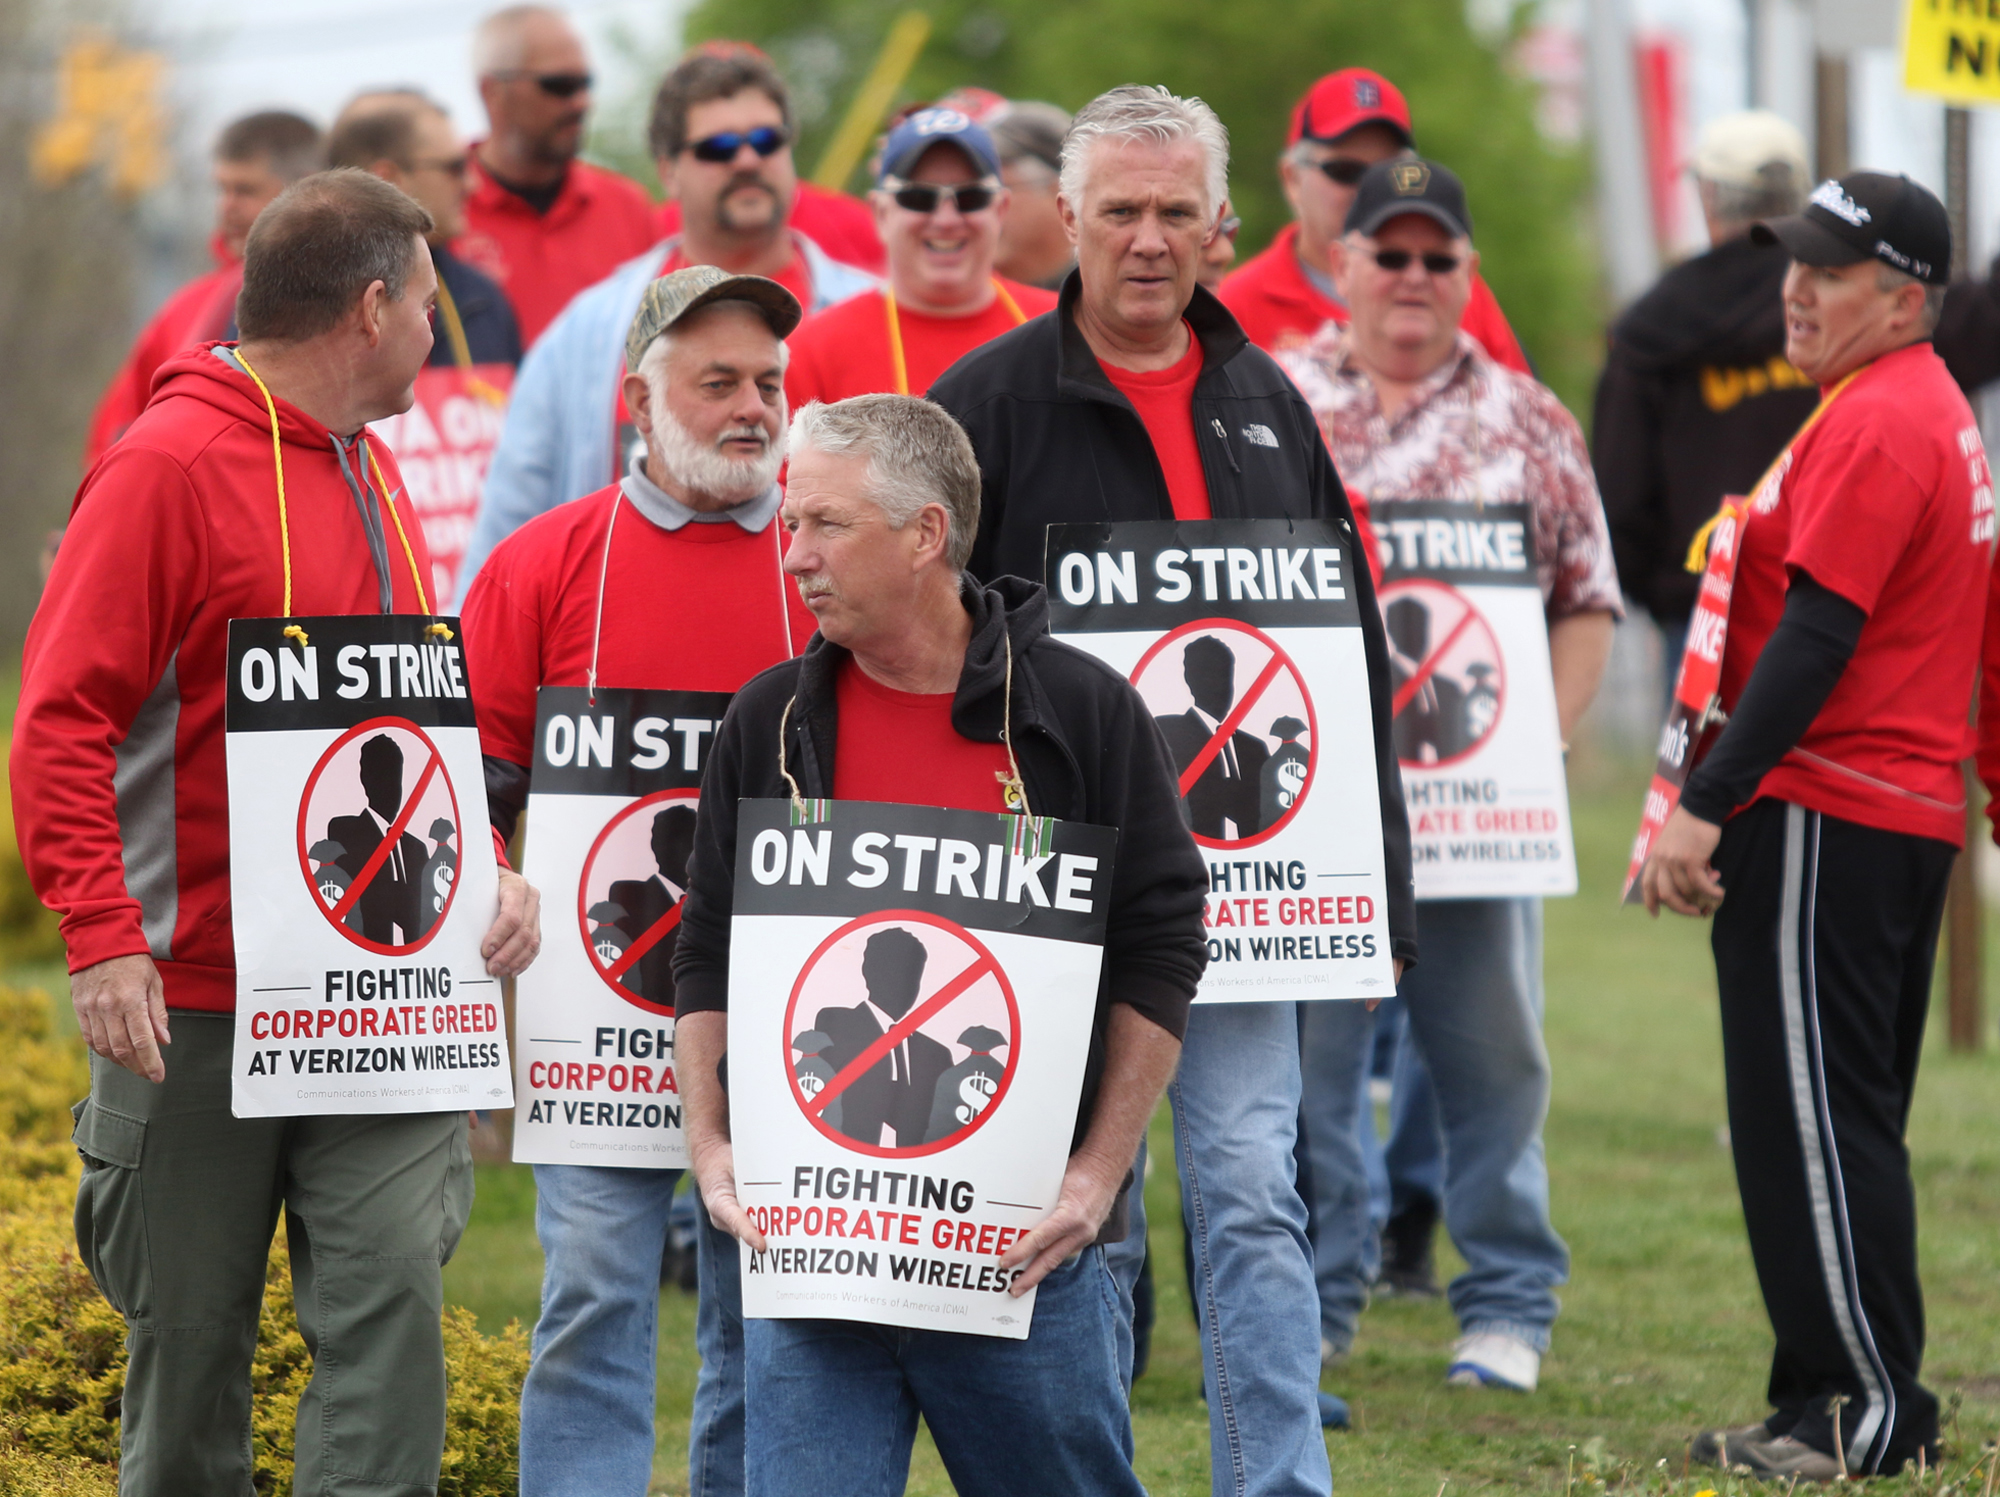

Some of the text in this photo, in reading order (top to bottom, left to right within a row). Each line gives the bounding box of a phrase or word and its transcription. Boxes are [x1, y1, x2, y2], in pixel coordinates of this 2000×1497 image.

[1060, 547, 1346, 606] ON STRIKE
[240, 644, 467, 702] ON STRIKE
[546, 714, 723, 771] ON ST
[1405, 778, 1499, 806] HTING
[1474, 808, 1558, 835] GREED
[1411, 838, 1562, 864] ON WIRELESS
[751, 828, 1099, 914] ON STRIKE
[1210, 860, 1307, 893] HTING
[1200, 896, 1375, 928] RATE GREED
[1206, 934, 1377, 963] ON WIRELESS
[325, 966, 452, 1003] FIGHTING
[1217, 976, 1254, 988] Workers
[1267, 974, 1302, 986] America
[251, 1003, 498, 1040] CORPORATE GREED
[247, 1042, 501, 1076] AT VERIZON WIRELESS
[595, 1026, 676, 1060] FIGH
[296, 1088, 377, 1100] Communications
[380, 1086, 415, 1098] Workers
[416, 1086, 425, 1097] of
[425, 1084, 451, 1096] America
[529, 1061, 680, 1095] CORPORA
[528, 1099, 682, 1129] AT VERIZON
[569, 1139, 687, 1154] Communications Worker
[793, 1166, 975, 1214] FIGHTING
[749, 1248, 766, 1275] AT
[771, 1247, 879, 1278] VERIZON
[775, 1290, 838, 1301] Communications
[842, 1291, 887, 1306] Workers
[889, 1298, 901, 1308] of
[902, 1299, 940, 1314] America
